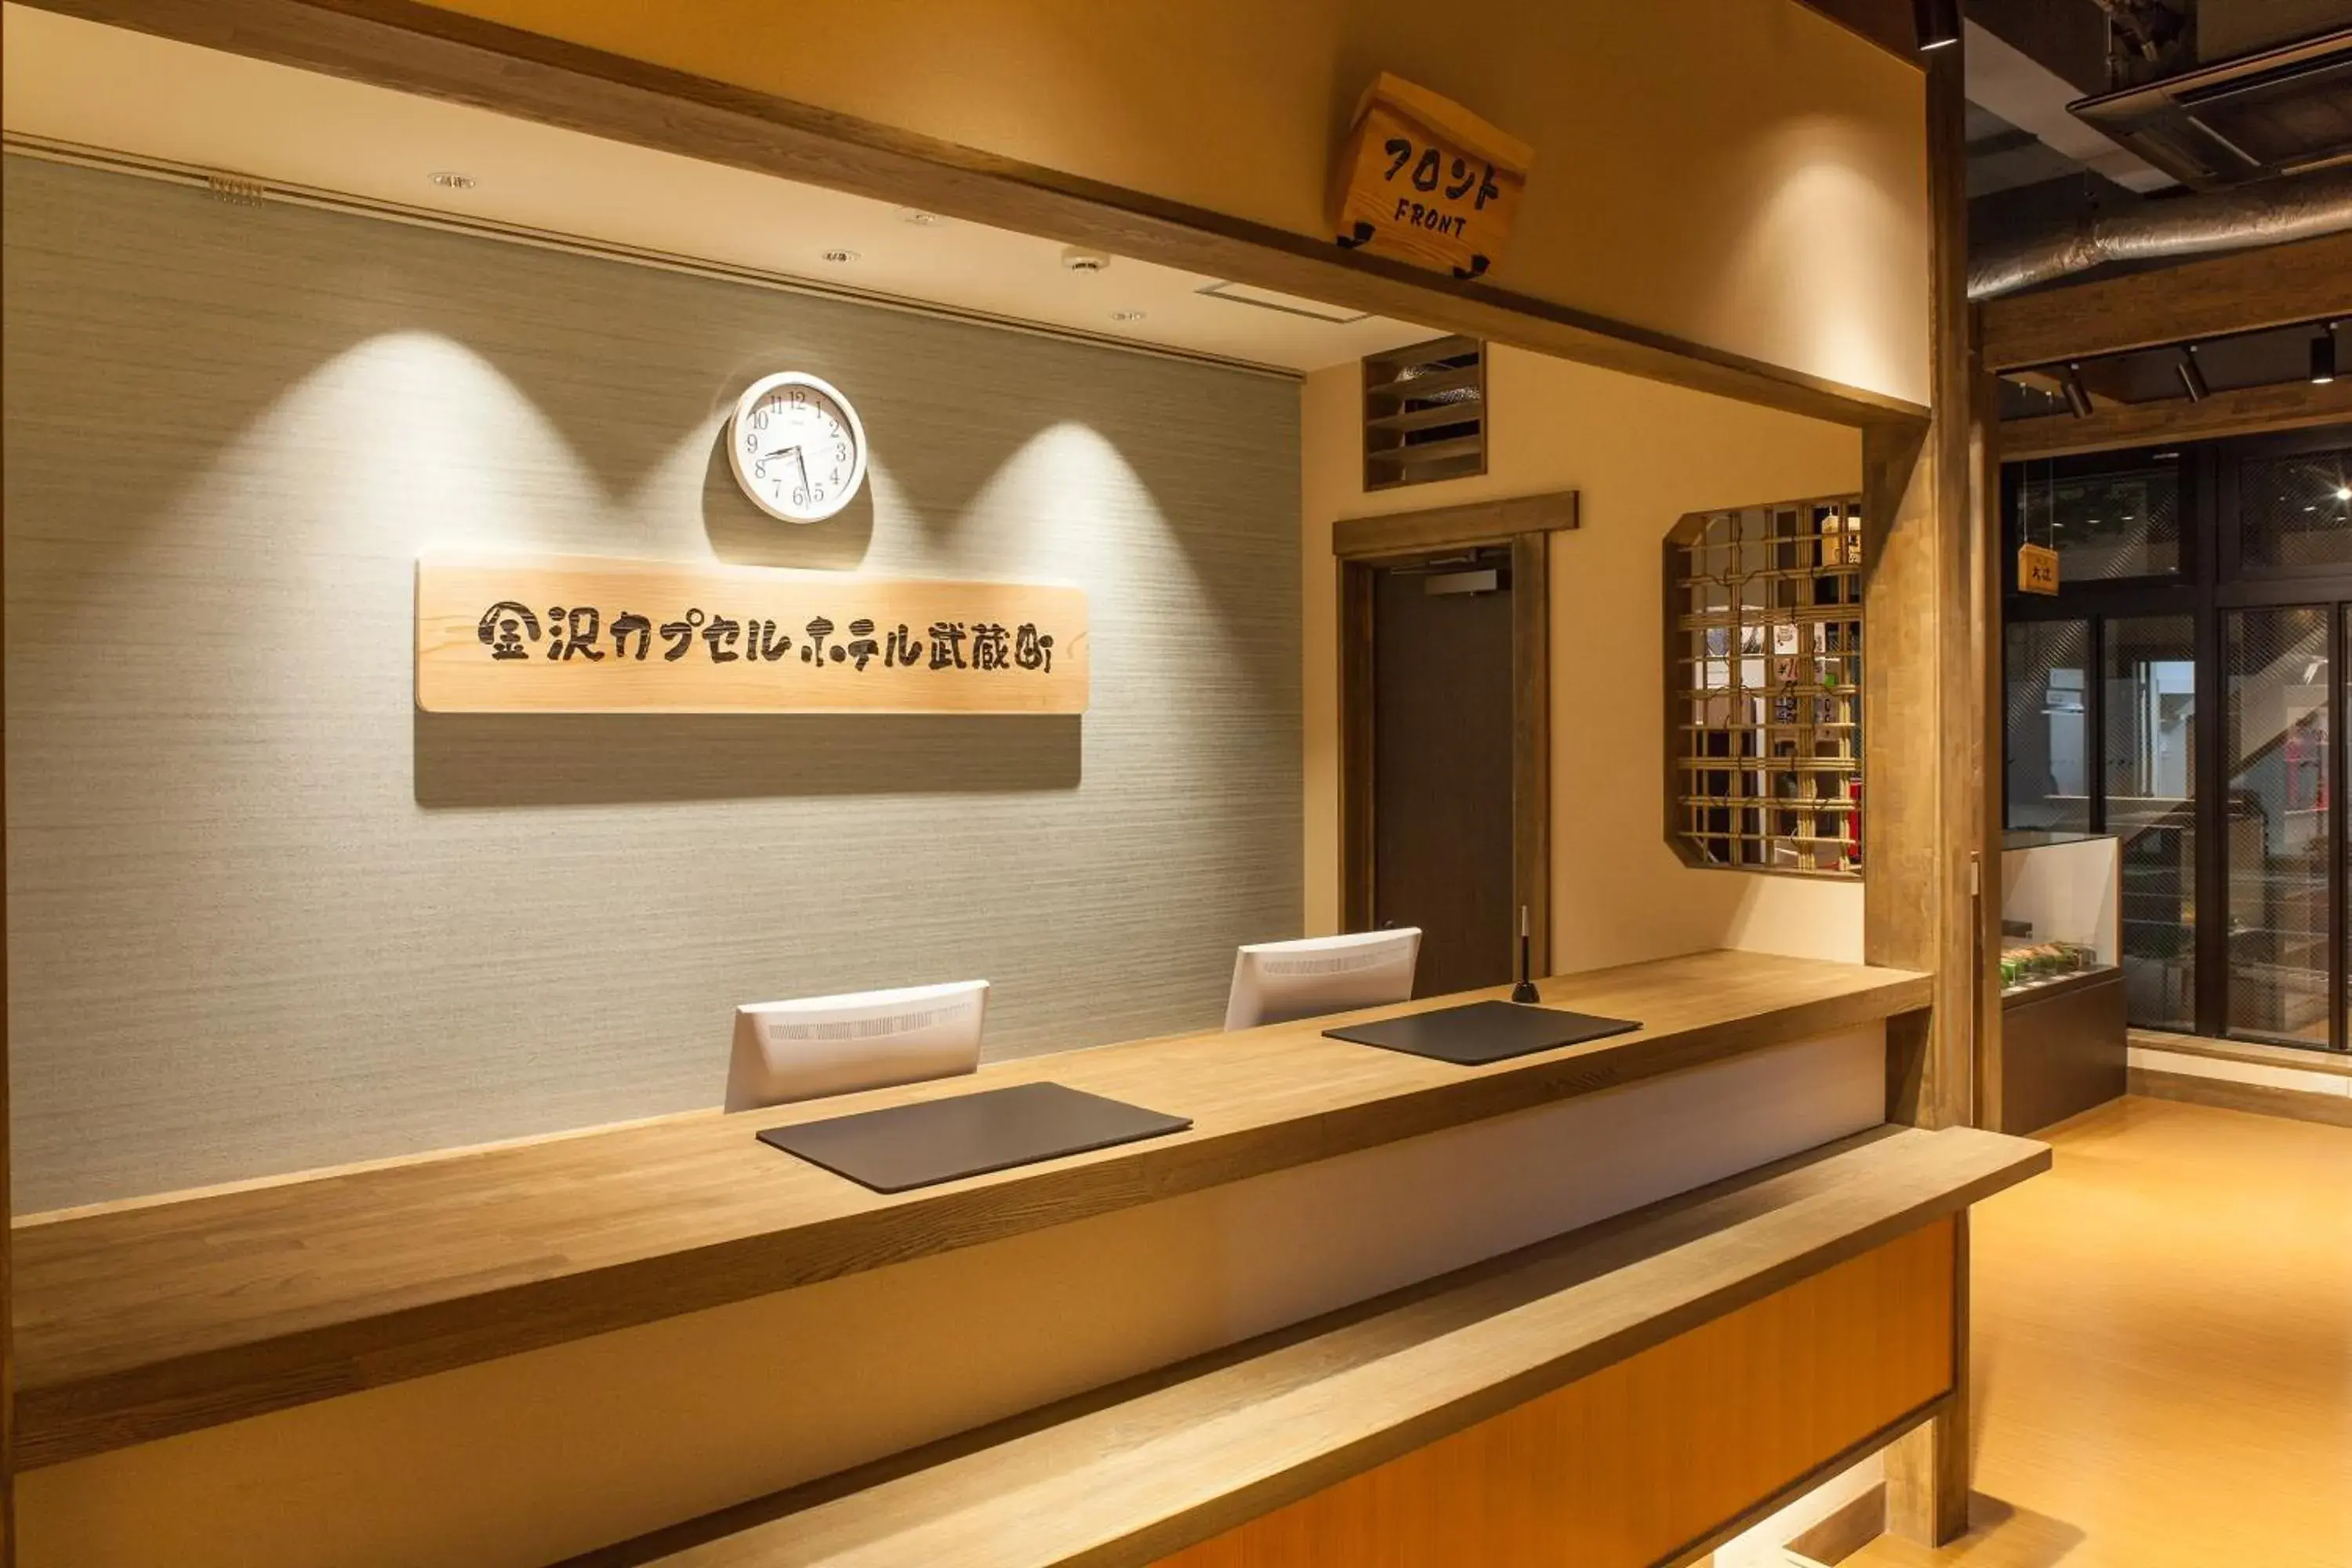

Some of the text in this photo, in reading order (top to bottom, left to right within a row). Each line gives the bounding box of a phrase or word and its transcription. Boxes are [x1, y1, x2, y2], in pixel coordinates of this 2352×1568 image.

[1385, 138, 1499, 210] フロント
[1394, 198, 1467, 238] FRONT
[771, 395, 783, 415] 11
[789, 391, 807, 410] 12
[816, 401, 822, 419] 1
[753, 411, 769, 430] 10
[829, 419, 840, 438] 2
[746, 434, 758, 454] 9
[836, 443, 847, 462] 3
[755, 459, 767, 479] 8
[829, 466, 840, 485] 4
[771, 478, 782, 499] 7
[793, 486, 804, 506] 6
[814, 482, 824, 502] 5
[477, 601, 1054, 674] 金沢カプセルホテル武蔵町
